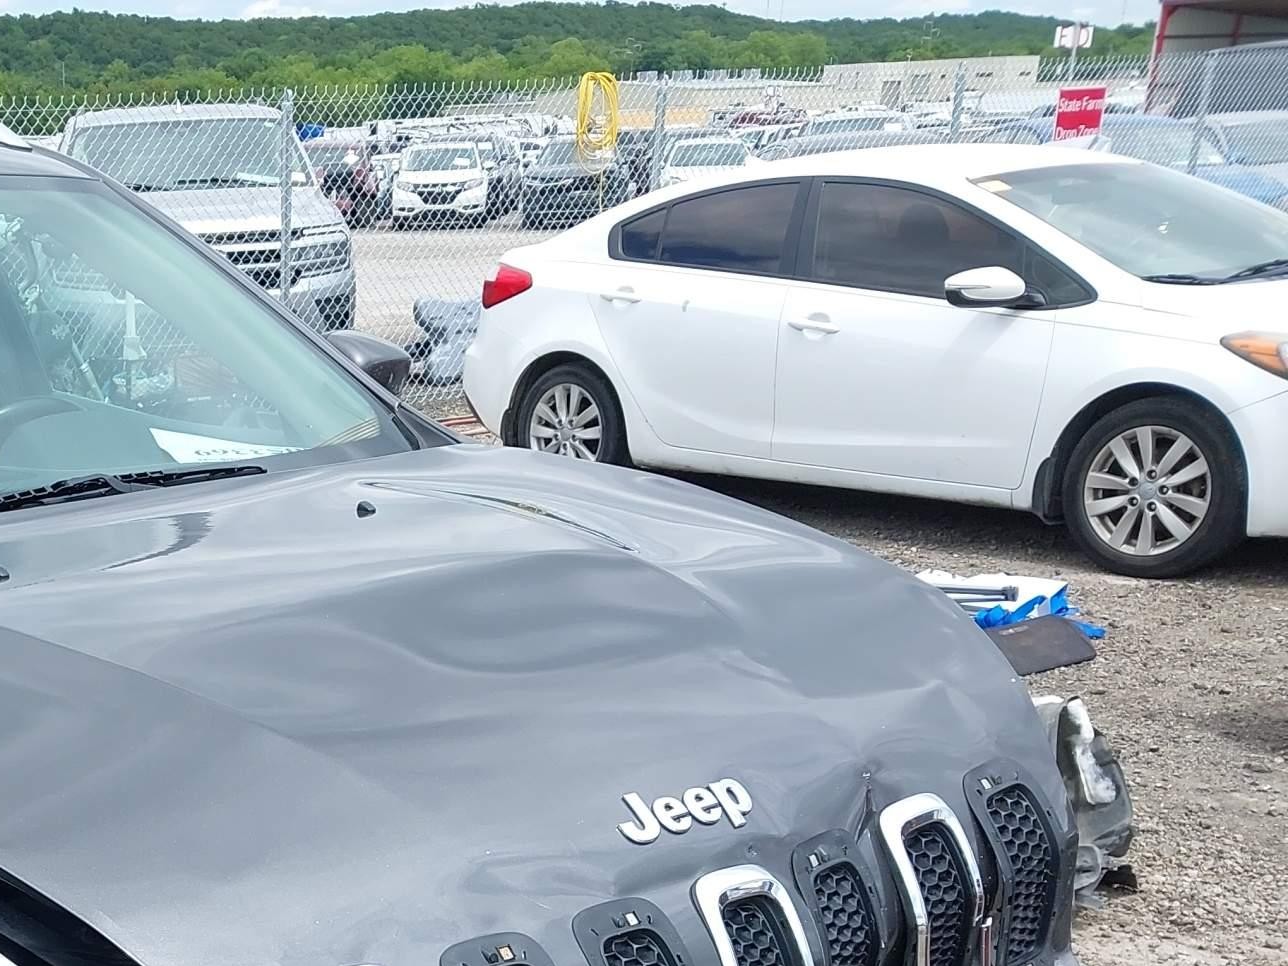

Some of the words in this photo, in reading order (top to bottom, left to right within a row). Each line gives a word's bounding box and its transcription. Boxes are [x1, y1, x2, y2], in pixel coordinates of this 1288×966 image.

[1058, 97, 1081, 112] State
[1082, 96, 1104, 111] Farm
[616, 777, 753, 845] Jeep
